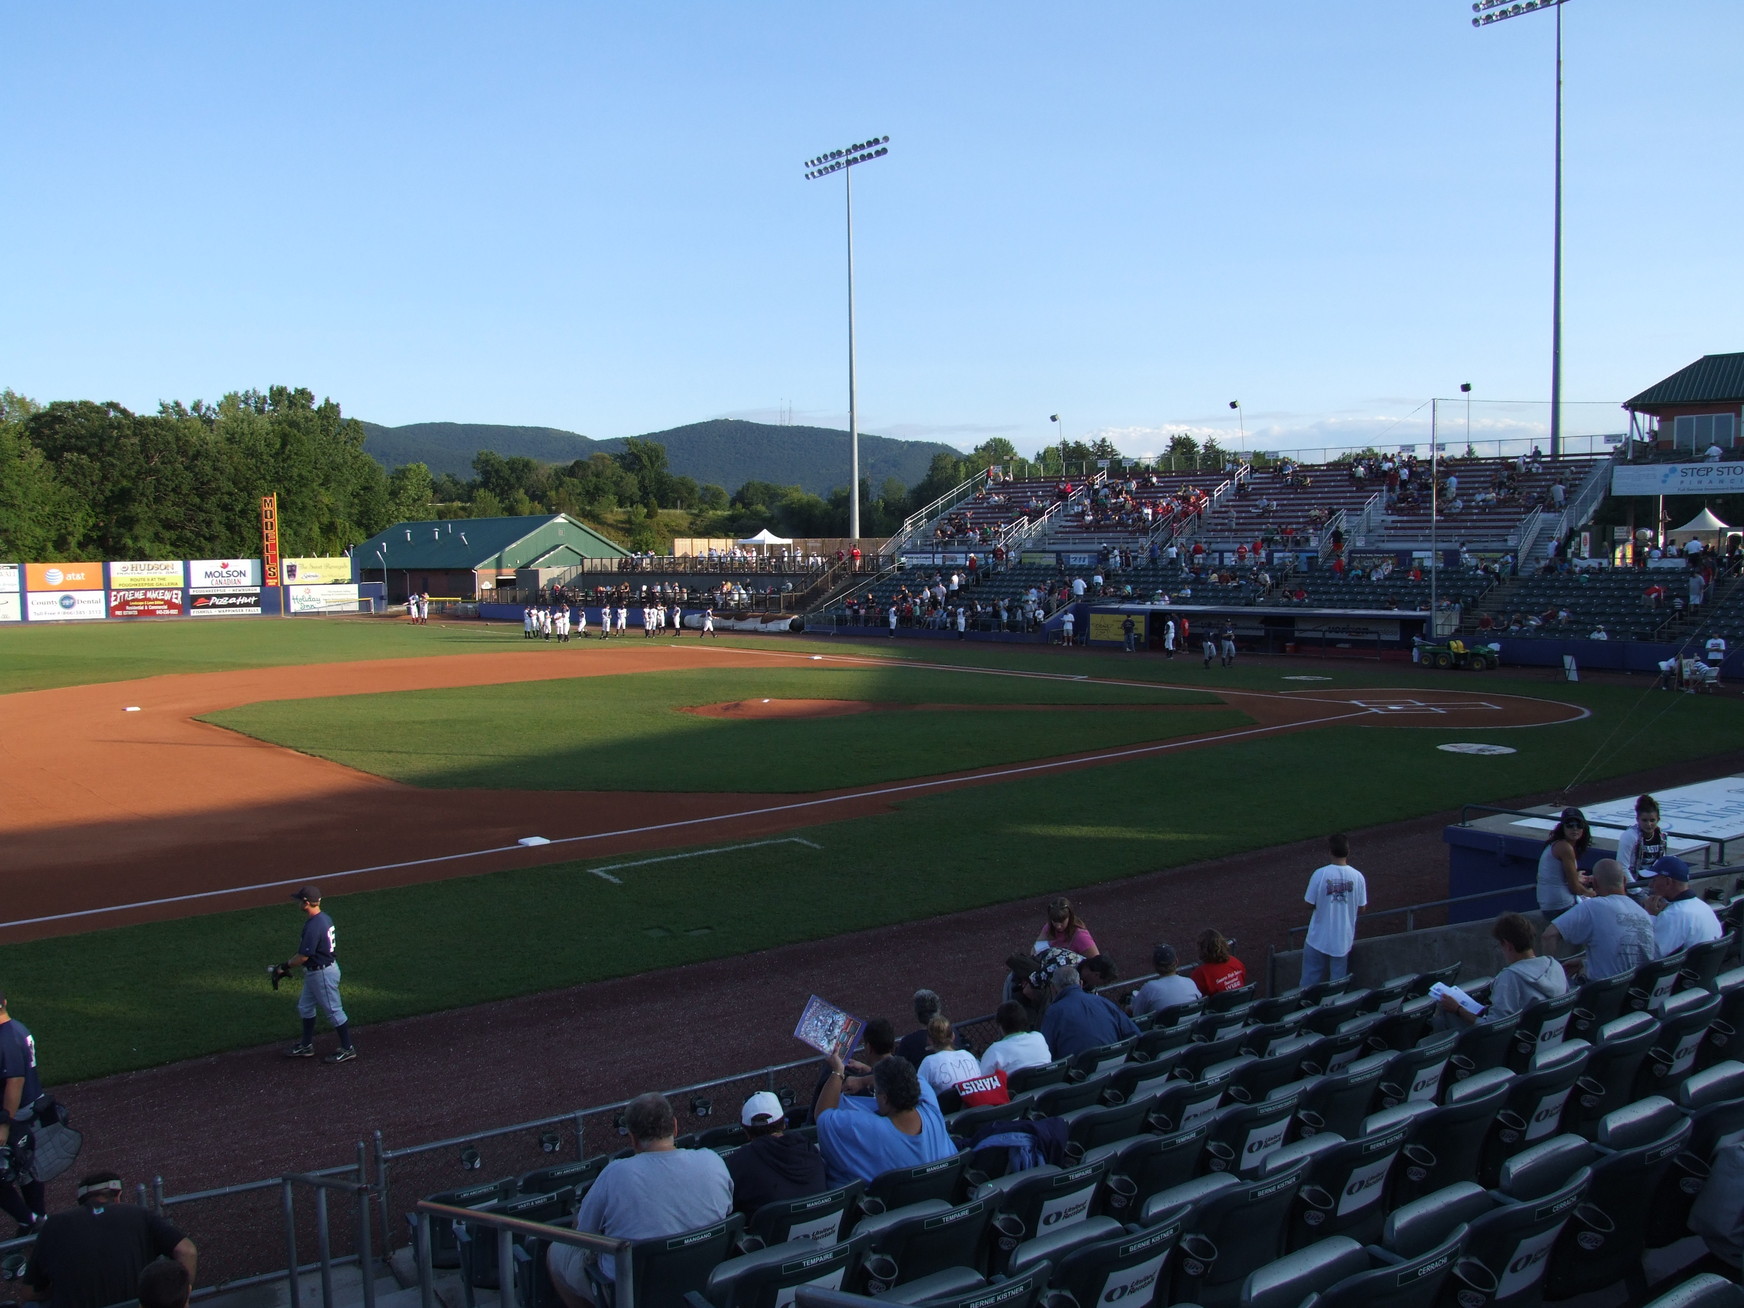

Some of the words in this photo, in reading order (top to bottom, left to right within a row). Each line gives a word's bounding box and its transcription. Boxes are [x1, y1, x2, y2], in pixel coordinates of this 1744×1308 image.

[1680, 467, 1713, 477] STEP
[131, 563, 174, 571] HUDSON
[204, 570, 246, 578] MOLSON
[66, 572, 85, 580] at&t
[31, 599, 58, 607] County
[110, 591, 146, 607] EXTREME
[146, 590, 182, 605] MAKEOVER
[209, 596, 236, 606] Pizza
[236, 596, 258, 605] Hut
[292, 594, 320, 604] Holiday
[955, 1075, 1001, 1096] MARIST
[926, 1162, 949, 1173] MANGANO
[1068, 1168, 1093, 1181] TEMPAIRE
[1257, 1185, 1277, 1198] BERNIE
[1277, 1176, 1297, 1192] KISTNER
[806, 1196, 832, 1209] MANGANO
[1064, 1199, 1087, 1214] United
[1552, 1195, 1577, 1214] CERRACHI
[942, 1208, 970, 1223] TEMPAIRE
[683, 1231, 712, 1245] MANGANO
[1129, 1239, 1151, 1253] BERNIE
[1151, 1228, 1175, 1245] KISTNER
[802, 1251, 834, 1268] TEMPAIRE
[1417, 1256, 1448, 1277] CERRACHI
[1130, 1271, 1158, 1289] United
[969, 1296, 996, 1308] BERNIE
[997, 1285, 1024, 1303] KISTNER
